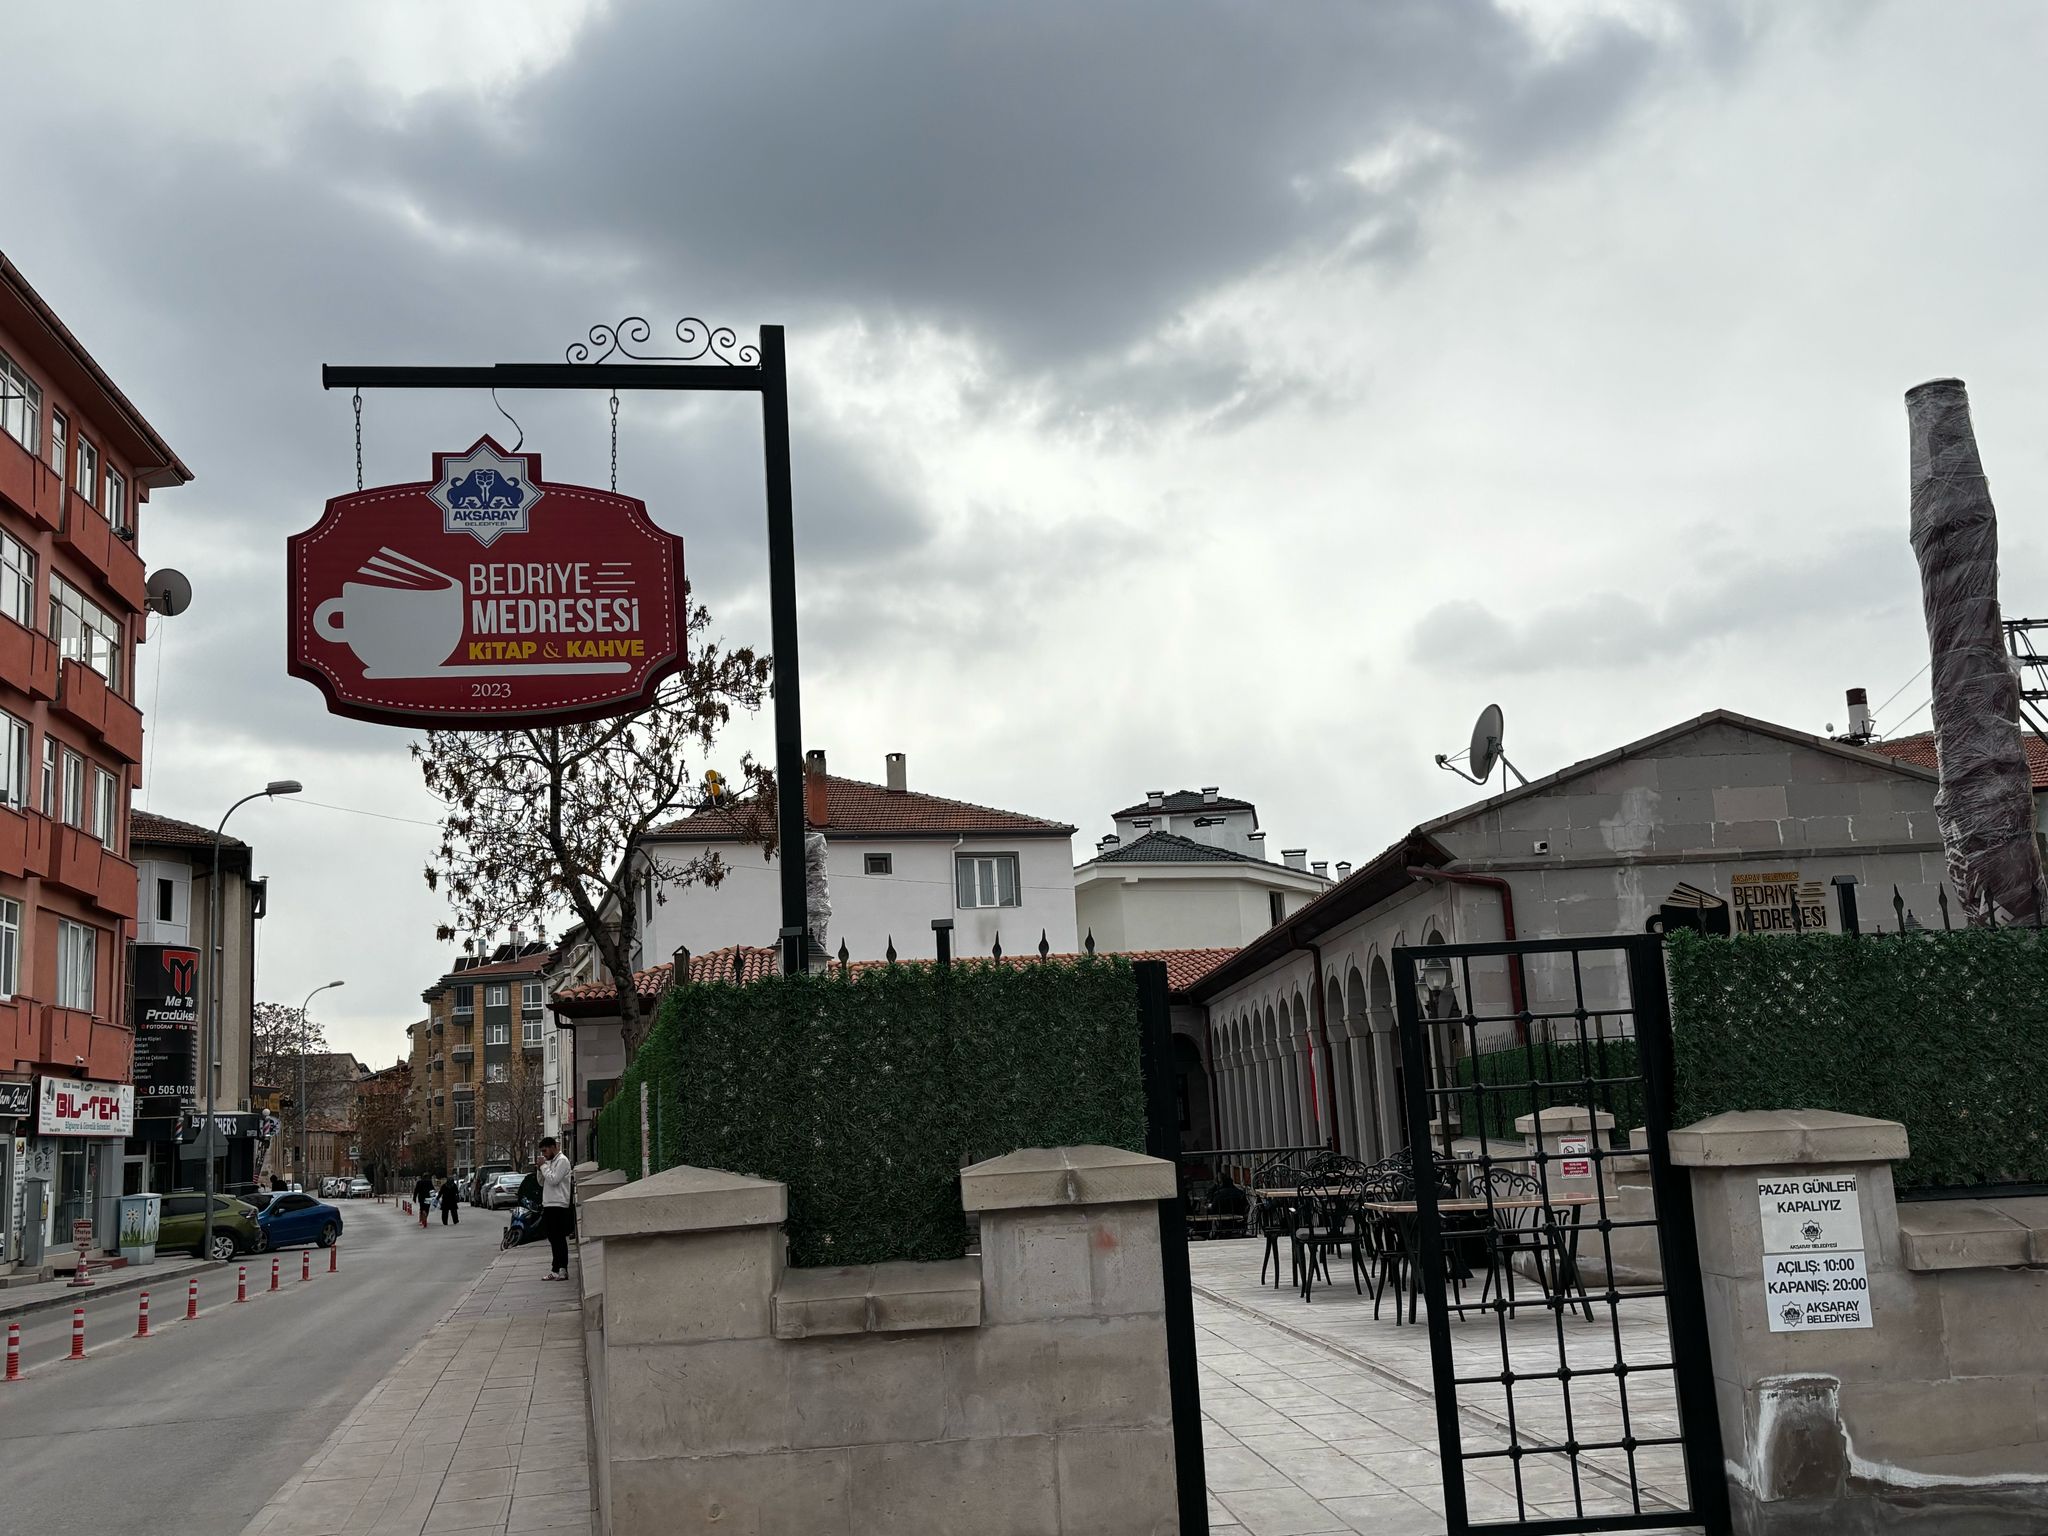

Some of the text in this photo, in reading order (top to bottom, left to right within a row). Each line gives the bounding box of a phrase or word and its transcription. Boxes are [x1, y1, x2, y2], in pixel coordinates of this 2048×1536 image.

[453, 510, 519, 521] AKSARAY
[543, 641, 563, 659] &
[567, 639, 645, 657] KAHVE
[471, 683, 512, 698] 2023
[1736, 906, 1827, 930] MEDREESİ
[164, 995, 182, 1007] Me
[145, 1009, 199, 1021] Prodüksi
[148, 1085, 156, 1095] 0
[158, 1085, 175, 1095] 505
[1758, 1177, 1857, 1196] PAZAR GÜNLERİ
[1777, 1199, 1842, 1213] KAPALIYIZ
[1776, 1258, 1855, 1277] AÇILIŞ: 10:00
[1768, 1277, 1867, 1297] KAPANIŞ: 20:00
[1806, 1300, 1860, 1313] AKSARAY
[1807, 1311, 1861, 1324] BELEDİYESİ
